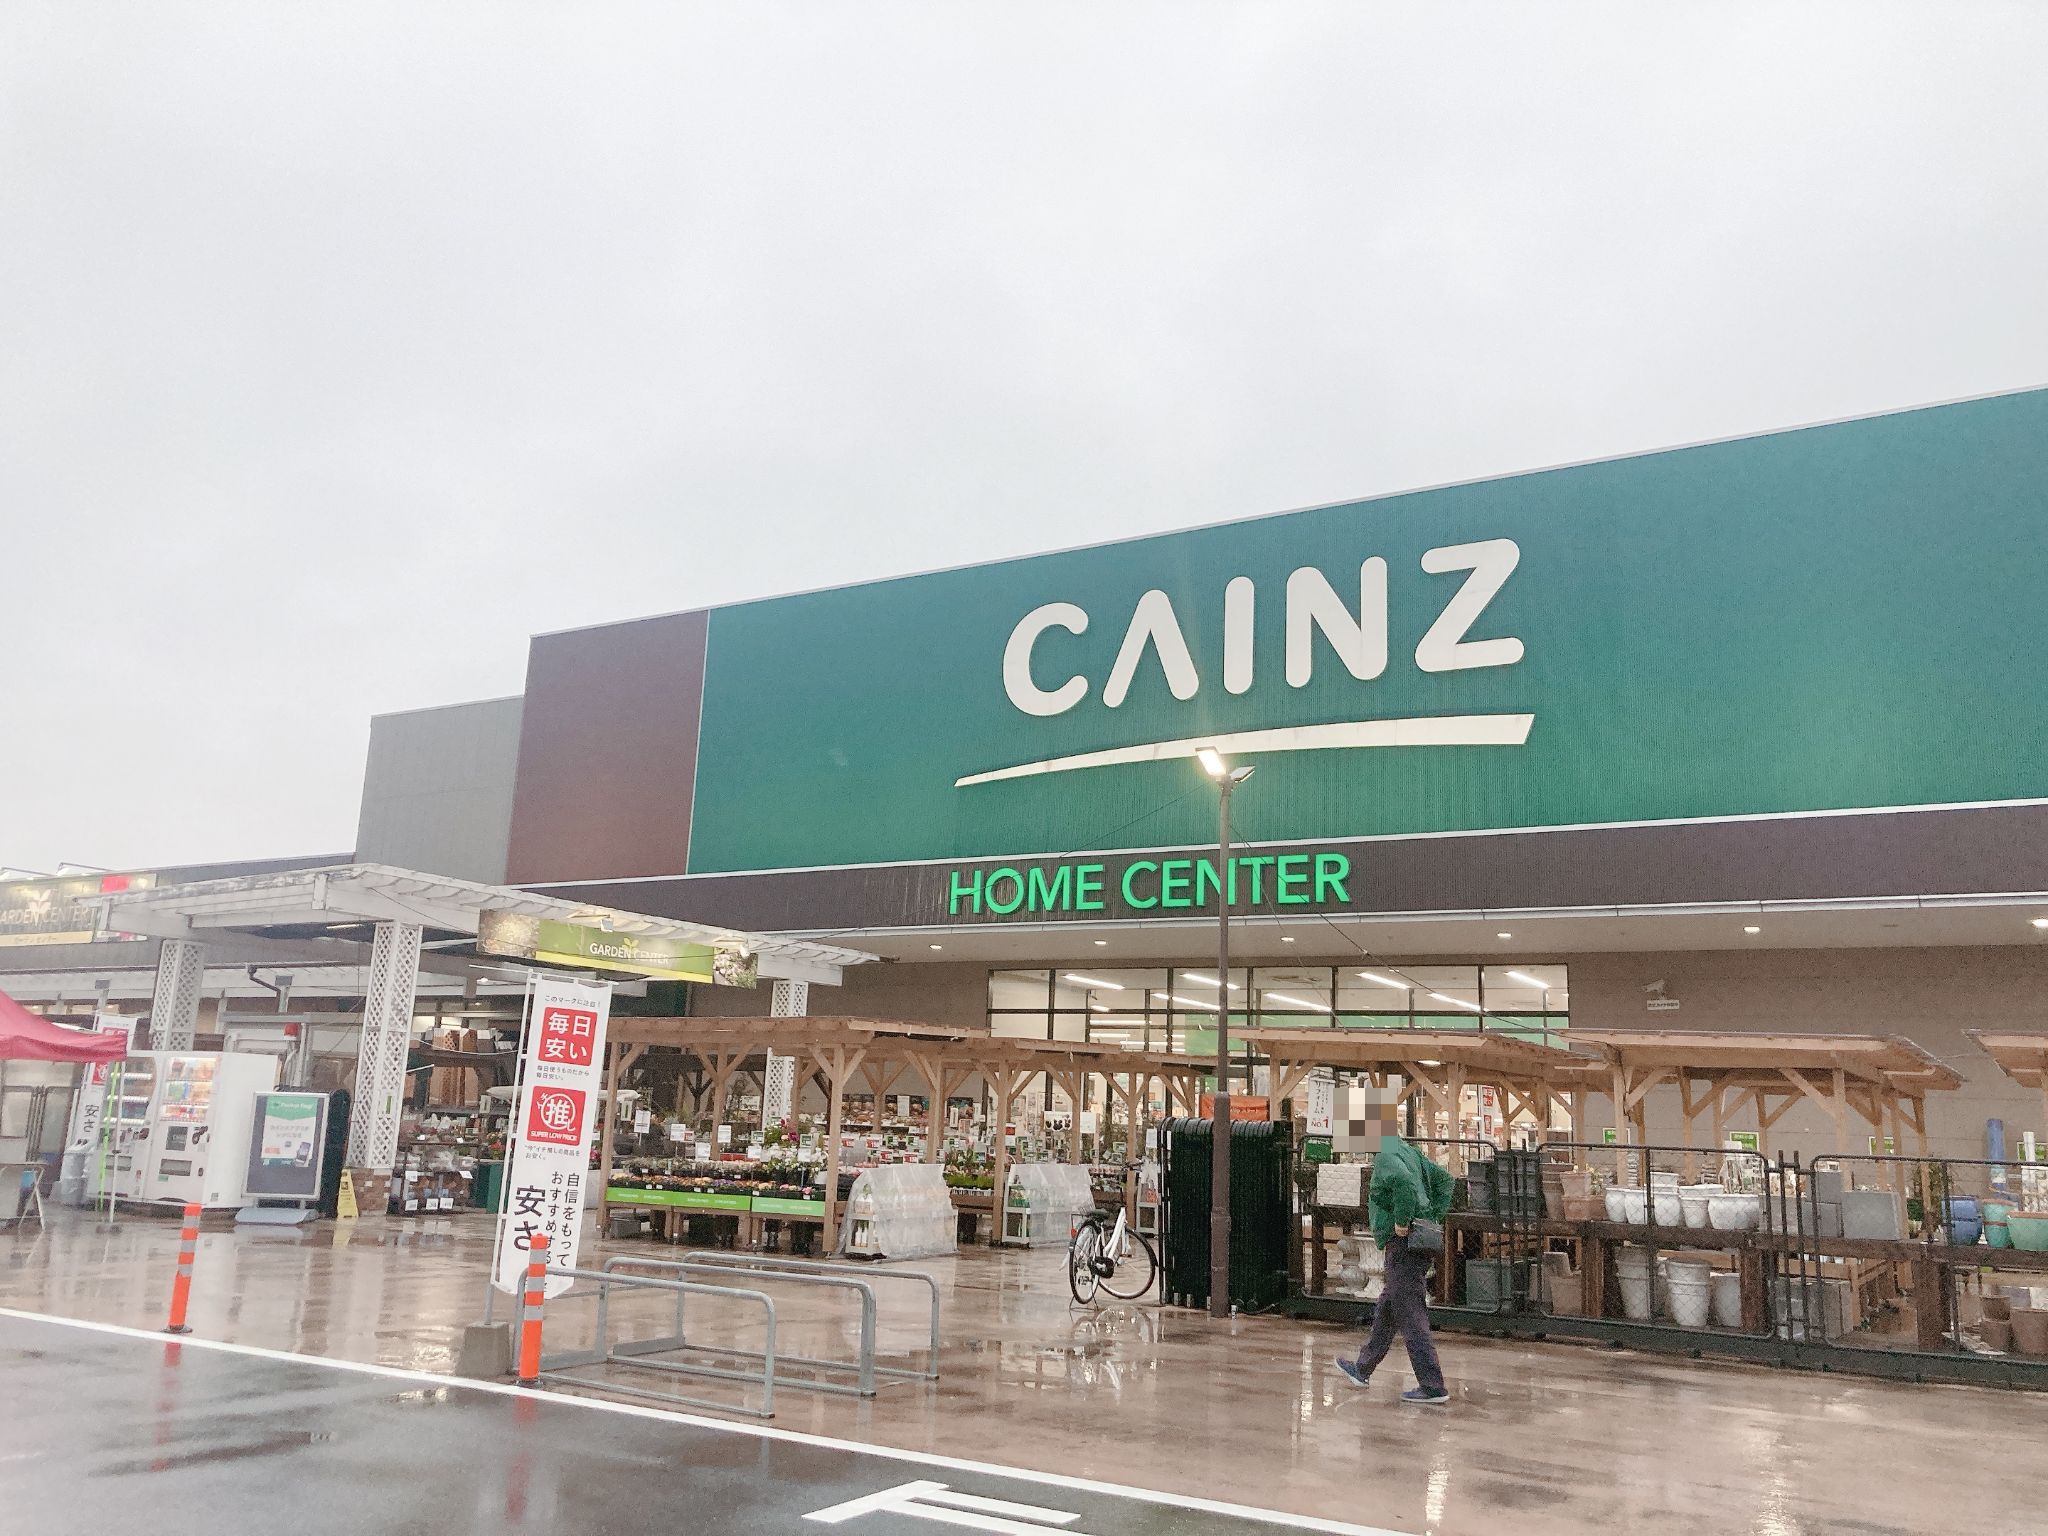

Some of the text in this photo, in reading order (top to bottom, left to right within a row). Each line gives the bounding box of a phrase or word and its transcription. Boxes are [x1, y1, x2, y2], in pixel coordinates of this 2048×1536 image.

[1003, 538, 1525, 717] CAINZ
[949, 852, 1351, 915] HOME CENTER
[590, 943, 670, 964] GARDEN CENTER
[545, 1037, 588, 1059] 安い
[548, 1011, 592, 1037] 毎日
[514, 1185, 546, 1252] 安さ
[556, 1173, 580, 1267] 自信をもって
